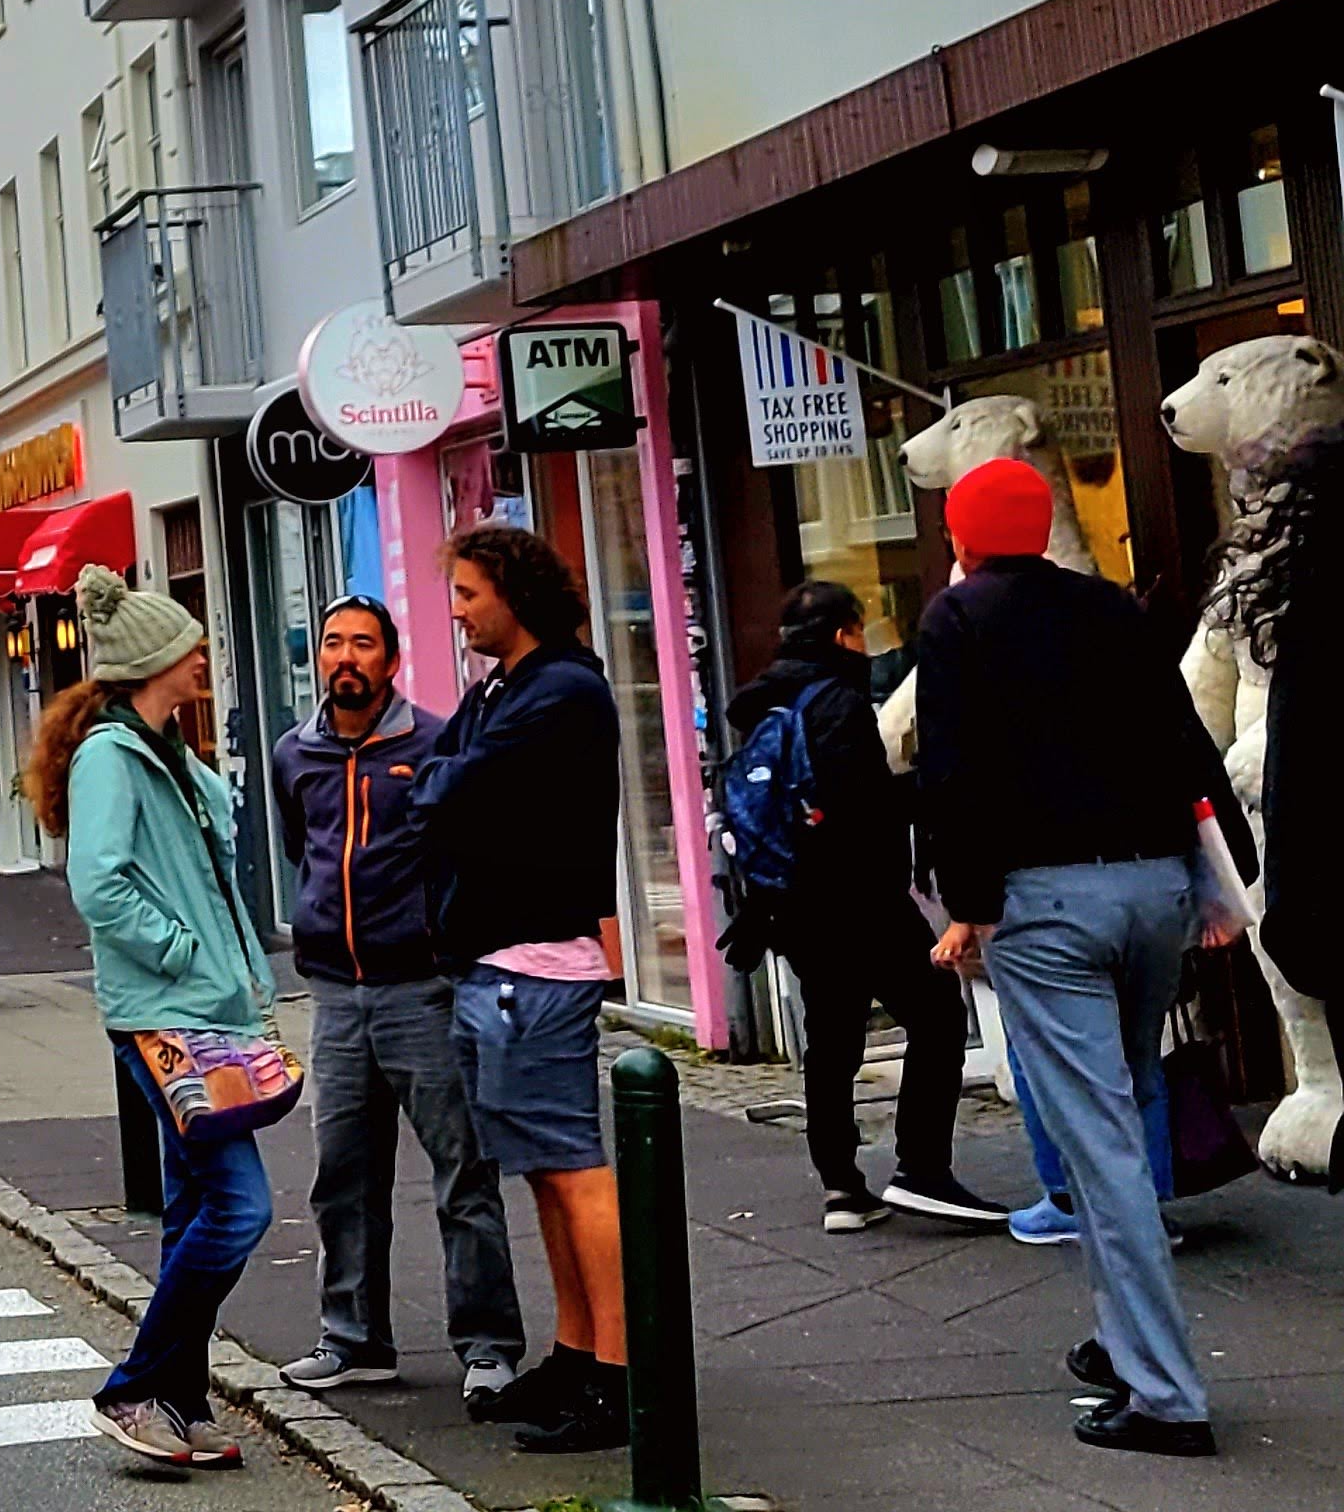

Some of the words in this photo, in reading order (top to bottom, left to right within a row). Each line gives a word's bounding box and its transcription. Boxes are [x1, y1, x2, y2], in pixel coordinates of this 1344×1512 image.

[527, 337, 610, 369] ATM
[339, 399, 438, 425] Scintilla
[760, 397, 795, 420] TAX
[803, 392, 848, 417] FREE
[763, 419, 852, 445] SHOPPING
[768, 447, 791, 460] SAVE
